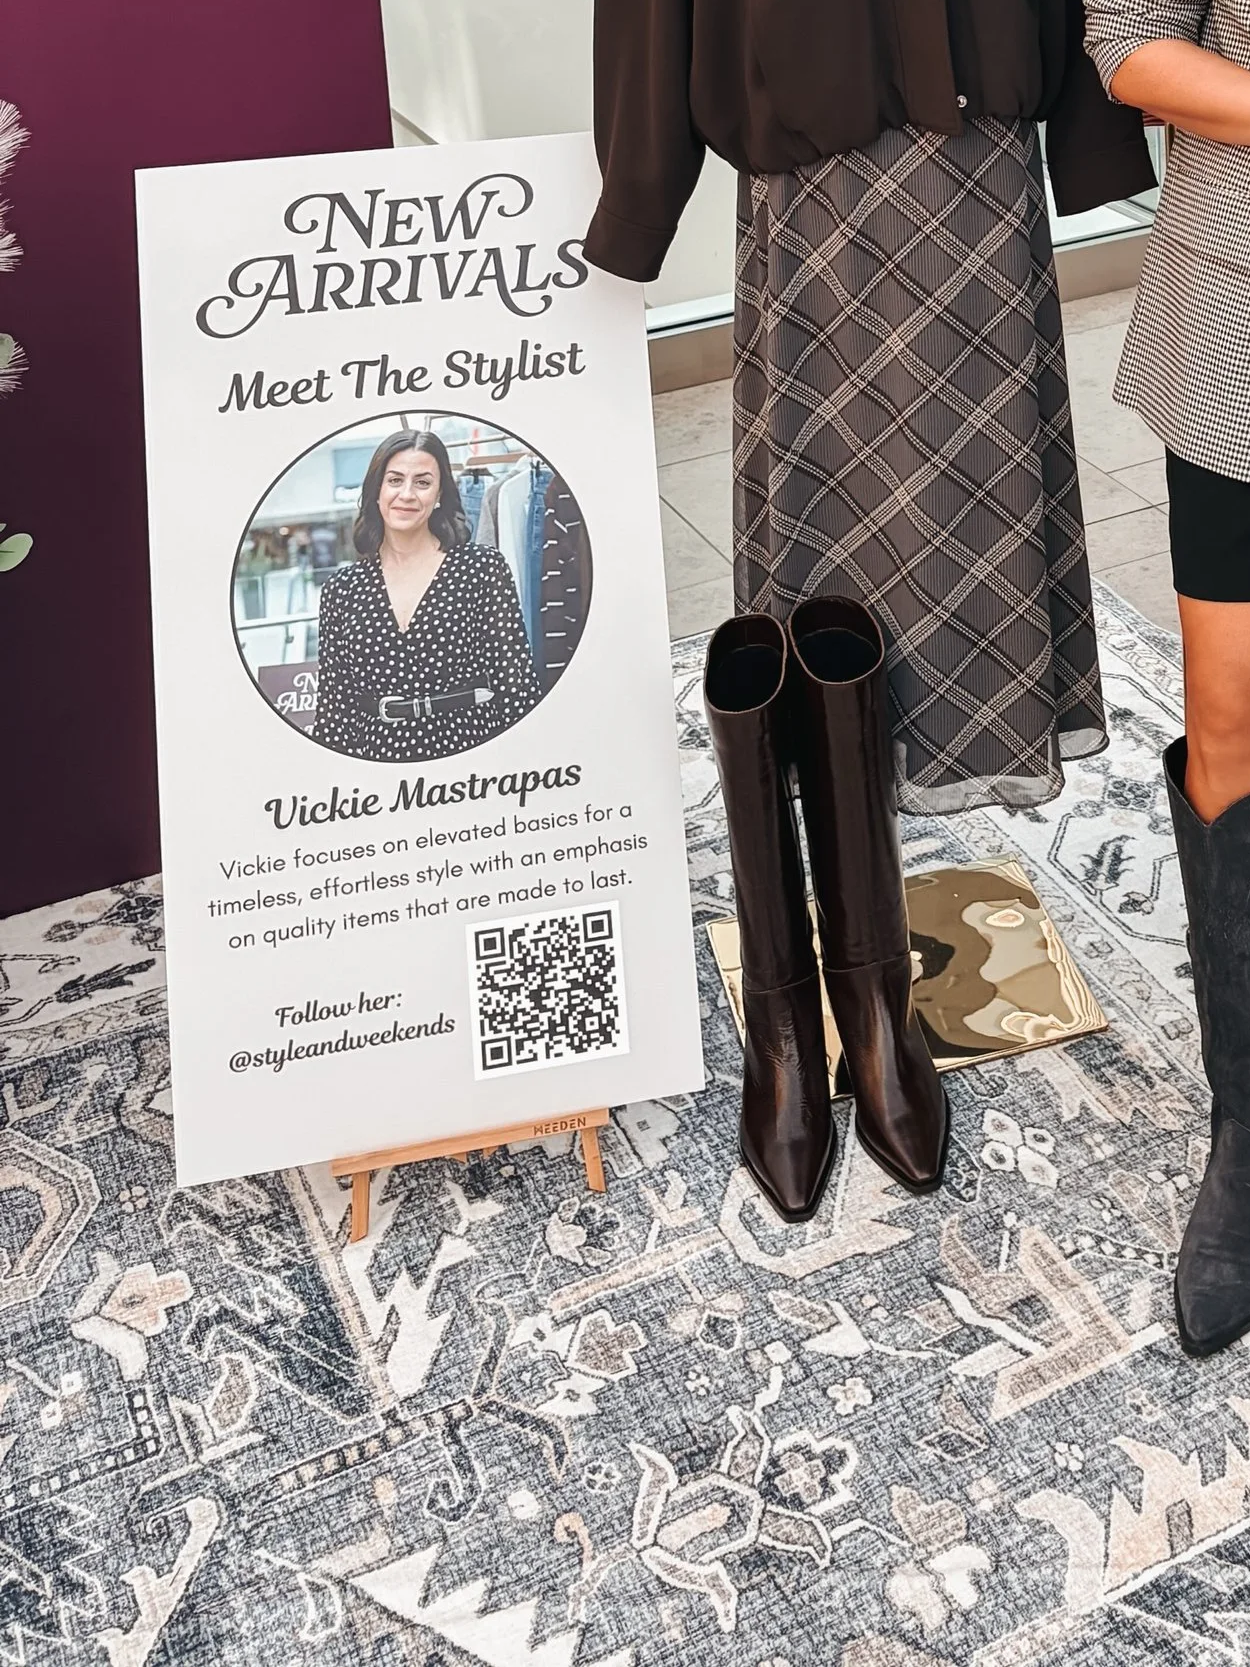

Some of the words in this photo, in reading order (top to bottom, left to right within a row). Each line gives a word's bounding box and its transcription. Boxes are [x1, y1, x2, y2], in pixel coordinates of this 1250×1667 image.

[283, 173, 534, 254] NEW
[195, 238, 589, 339] ARRIVALS
[218, 369, 333, 414] Meet
[340, 354, 433, 399] The
[443, 339, 586, 401] Stylist
[264, 786, 383, 830] Vickie
[389, 764, 582, 813] Mastrapas
[207, 889, 302, 918] timeless,
[309, 871, 410, 900] effortless
[416, 859, 464, 887] style
[469, 850, 514, 875] with
[520, 852, 546, 867] an
[553, 833, 648, 863] emphasis
[219, 853, 286, 880] Vickie
[293, 844, 376, 869] focuses
[382, 839, 409, 854] on
[415, 816, 506, 850] elevated
[513, 812, 579, 834] basics
[584, 803, 613, 823] for
[619, 805, 632, 818] a
[228, 933, 255, 949] on
[263, 916, 336, 948] quality
[343, 909, 400, 931] items
[406, 897, 449, 919] that
[456, 894, 491, 911] are
[498, 878, 557, 905] made
[562, 878, 584, 894] to
[590, 869, 633, 891] last.
[229, 1012, 456, 1073] @styleandweekends
[274, 1000, 356, 1028] Follow
[357, 991, 403, 1014] her:
[533, 1116, 587, 1136] MEEDEN
